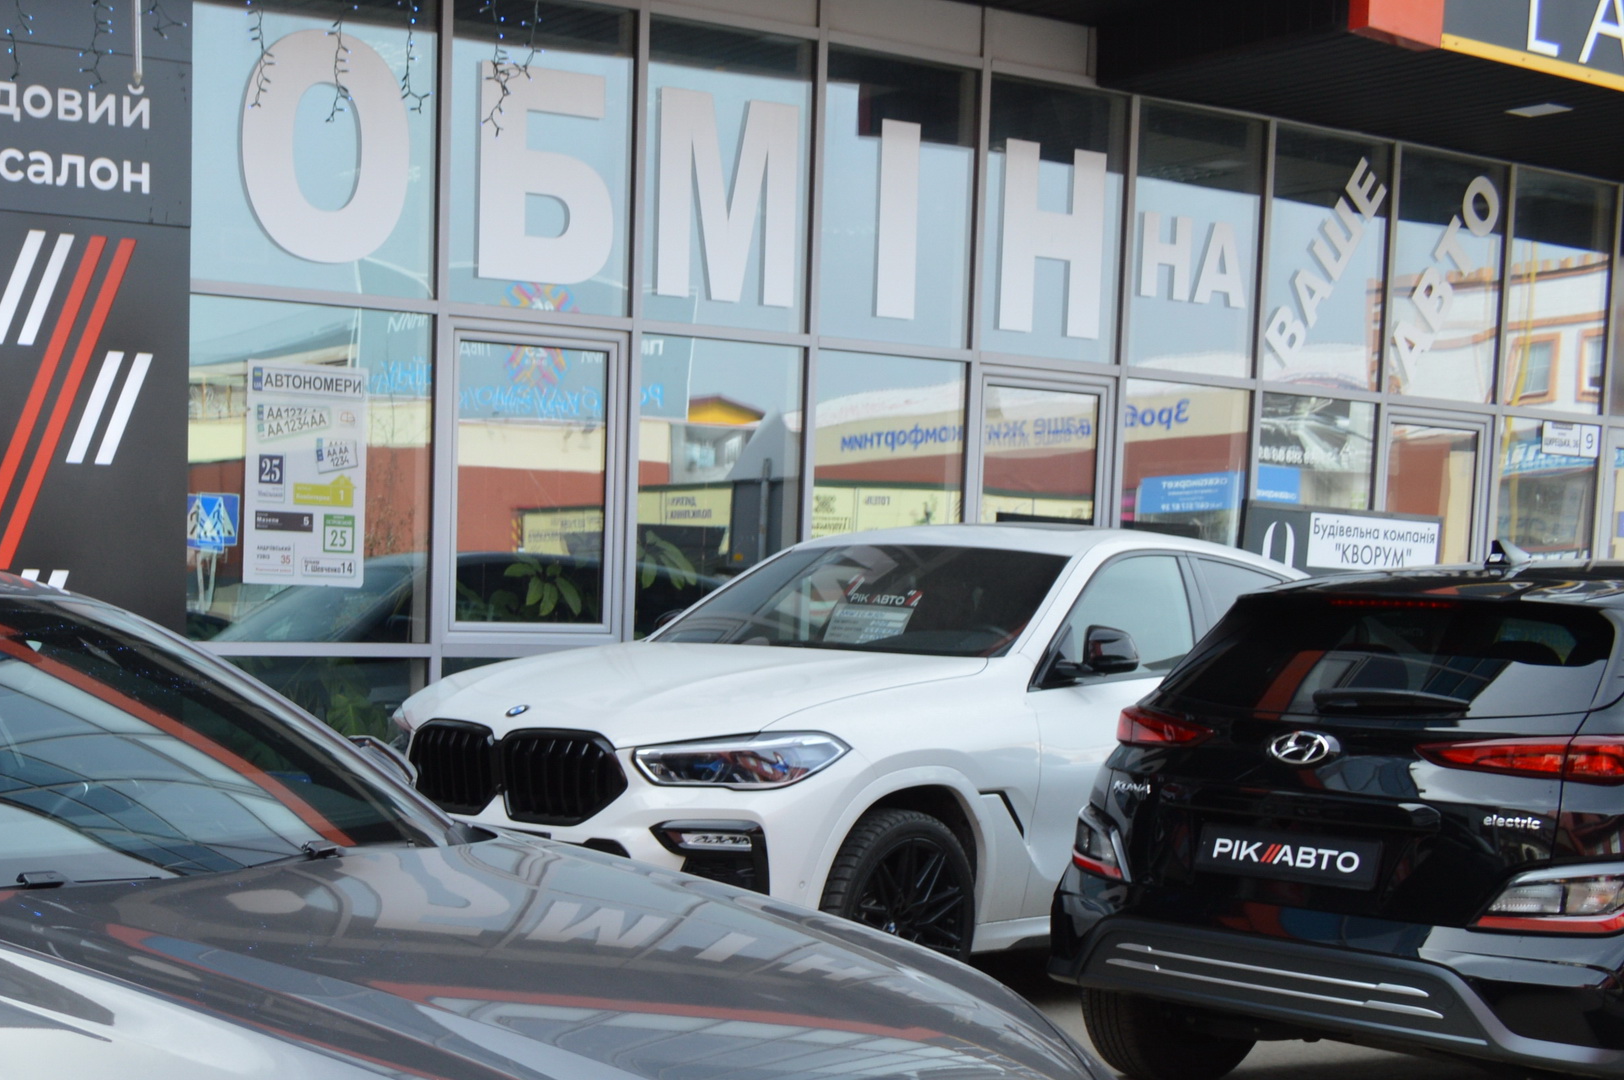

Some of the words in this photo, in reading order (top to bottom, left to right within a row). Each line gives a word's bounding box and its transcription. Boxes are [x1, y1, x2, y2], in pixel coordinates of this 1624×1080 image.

[1140, 210, 1246, 310] НА
[264, 372, 362, 394] АВТОНОМЕРИ
[1586, 433, 1594, 449] 9
[261, 457, 280, 482] 25
[330, 529, 347, 547] 25
[1313, 516, 1379, 540] Будівельна
[1382, 527, 1436, 544] компанія
[1334, 544, 1412, 569] "КВОРУМ"
[341, 562, 353, 575] 14
[1483, 814, 1541, 830] electric
